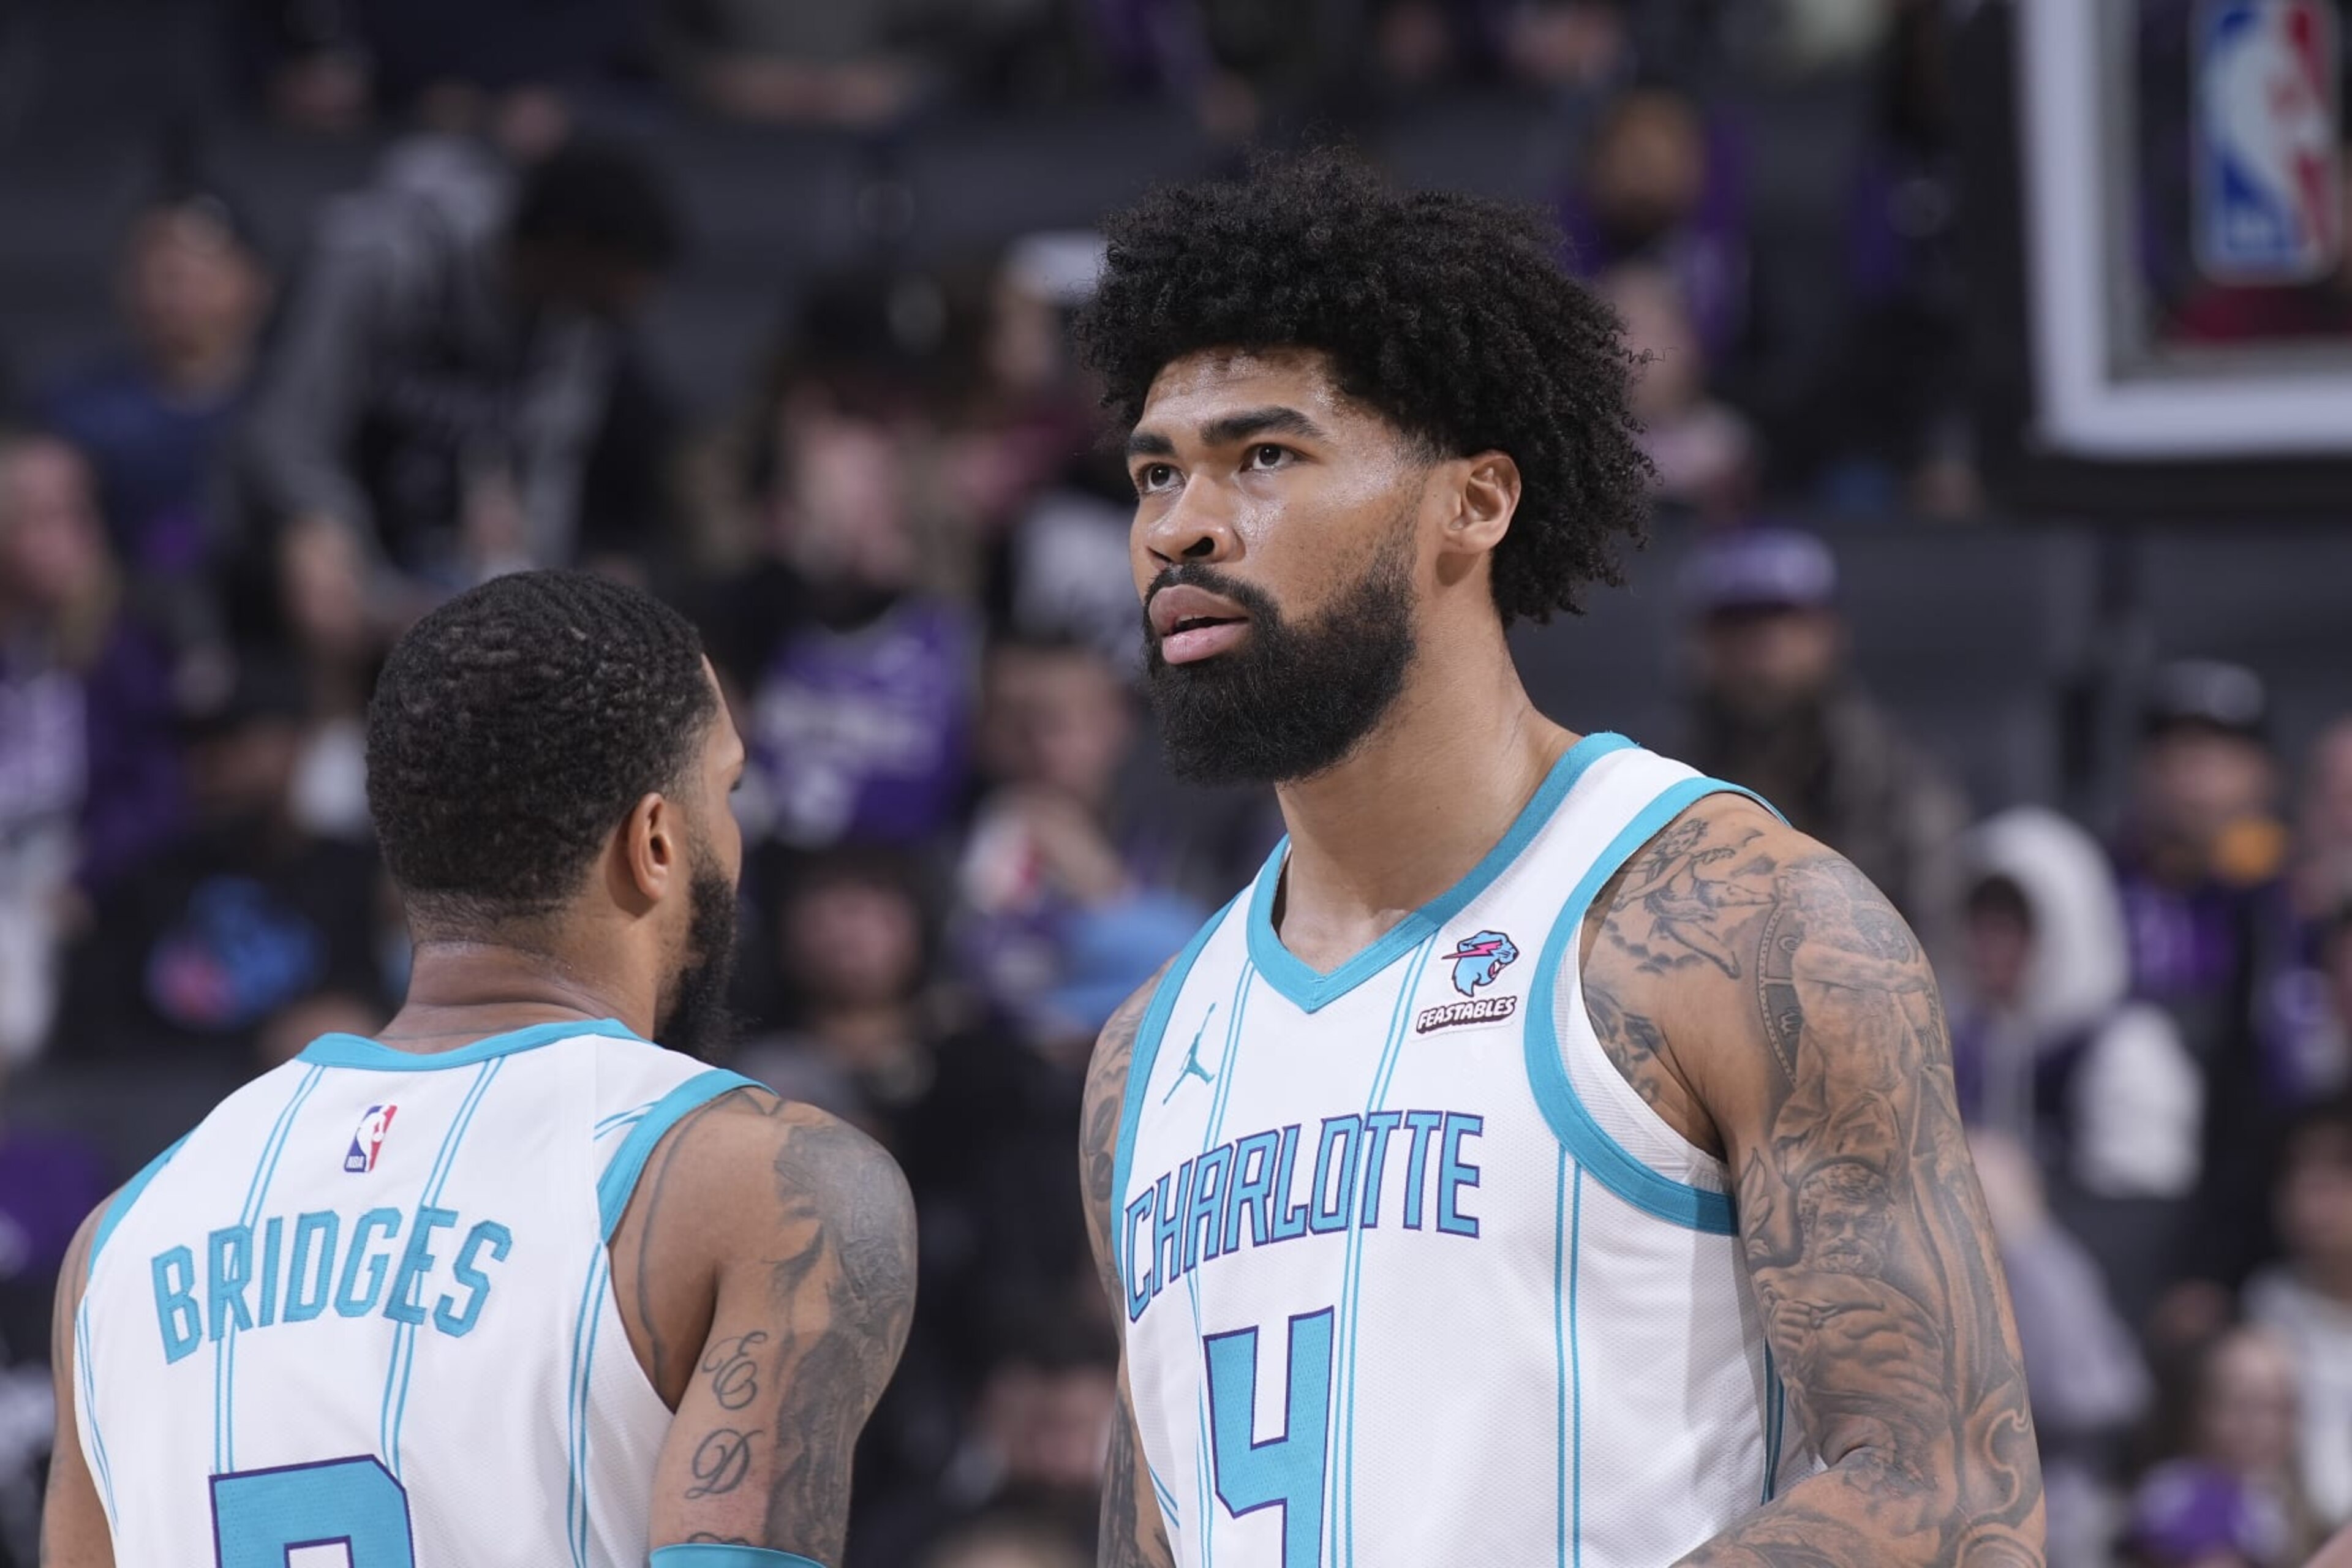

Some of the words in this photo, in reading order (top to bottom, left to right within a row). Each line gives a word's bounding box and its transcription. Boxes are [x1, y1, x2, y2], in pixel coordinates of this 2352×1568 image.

[1417, 997, 1517, 1033] FEASTABLES
[152, 1205, 512, 1365] BRIDGES
[1126, 1110, 1483, 1322] CHARLOTTE
[1202, 1305, 1334, 1568] 4
